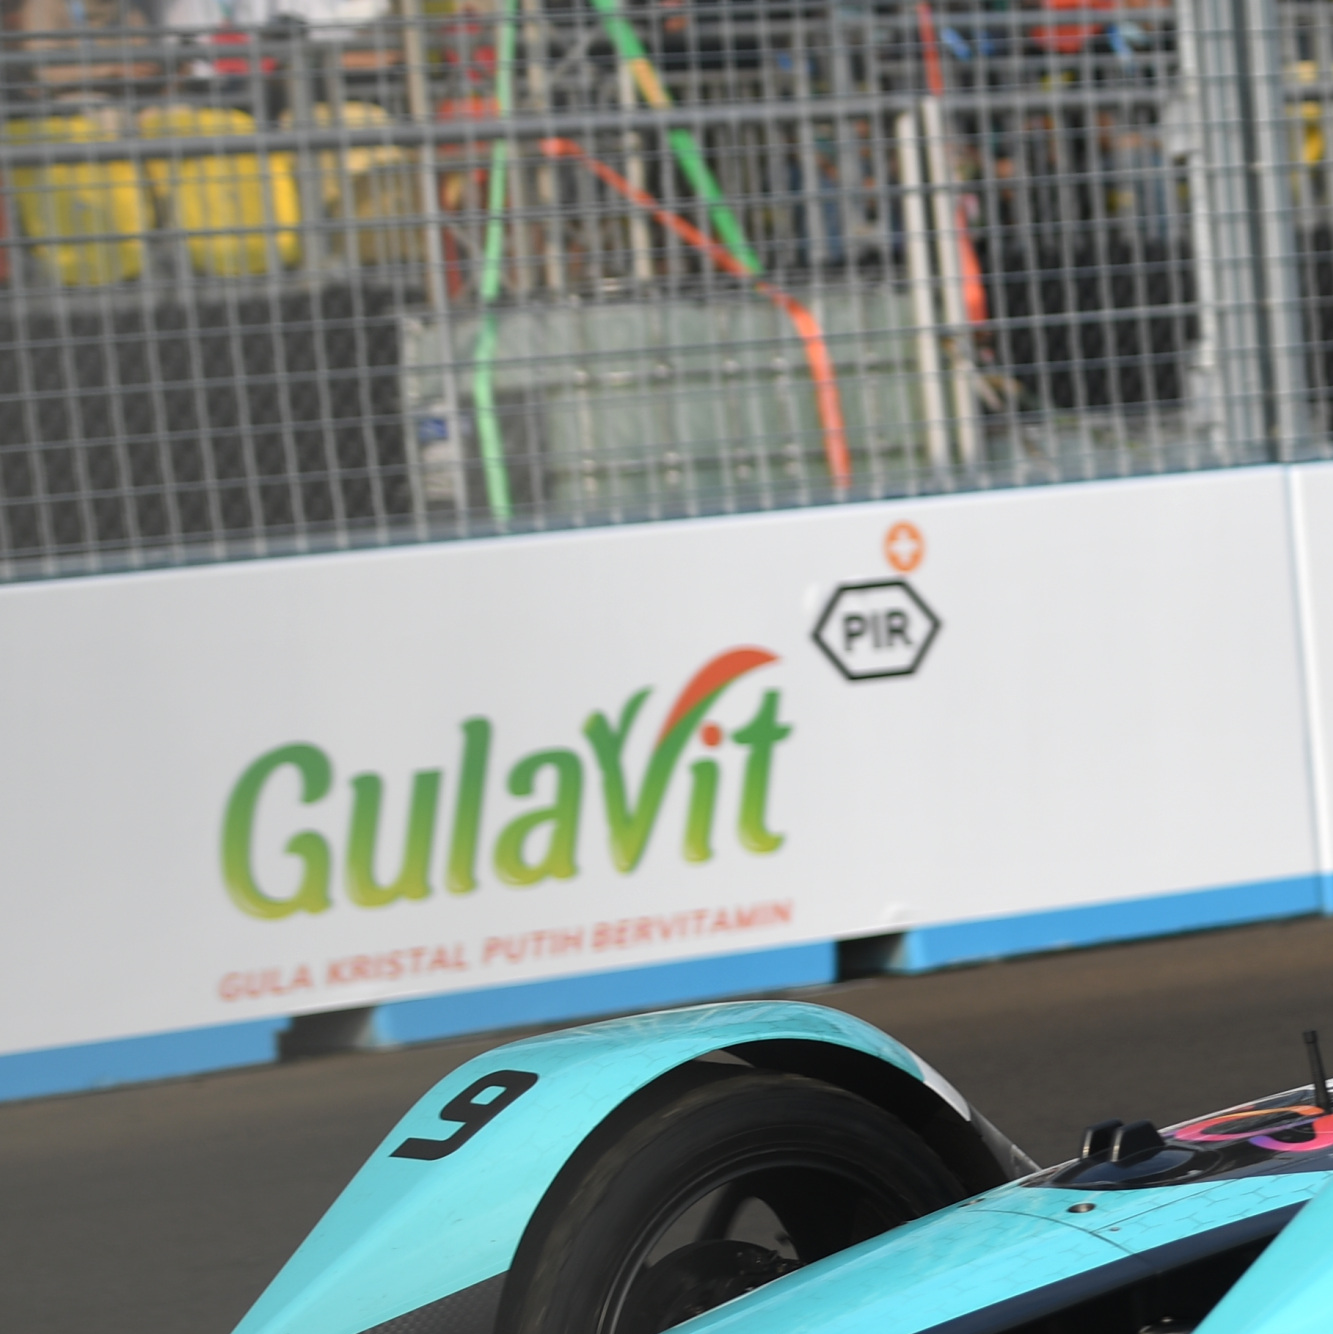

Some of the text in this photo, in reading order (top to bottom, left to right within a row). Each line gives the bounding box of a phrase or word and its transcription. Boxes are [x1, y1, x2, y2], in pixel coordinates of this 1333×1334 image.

[842, 609, 914, 653] PIR
[220, 645, 796, 920] GulaVit
[217, 899, 797, 1003] GULA KRISTAL PUTIH BERVITAMIN
[389, 1069, 540, 1161] 9
